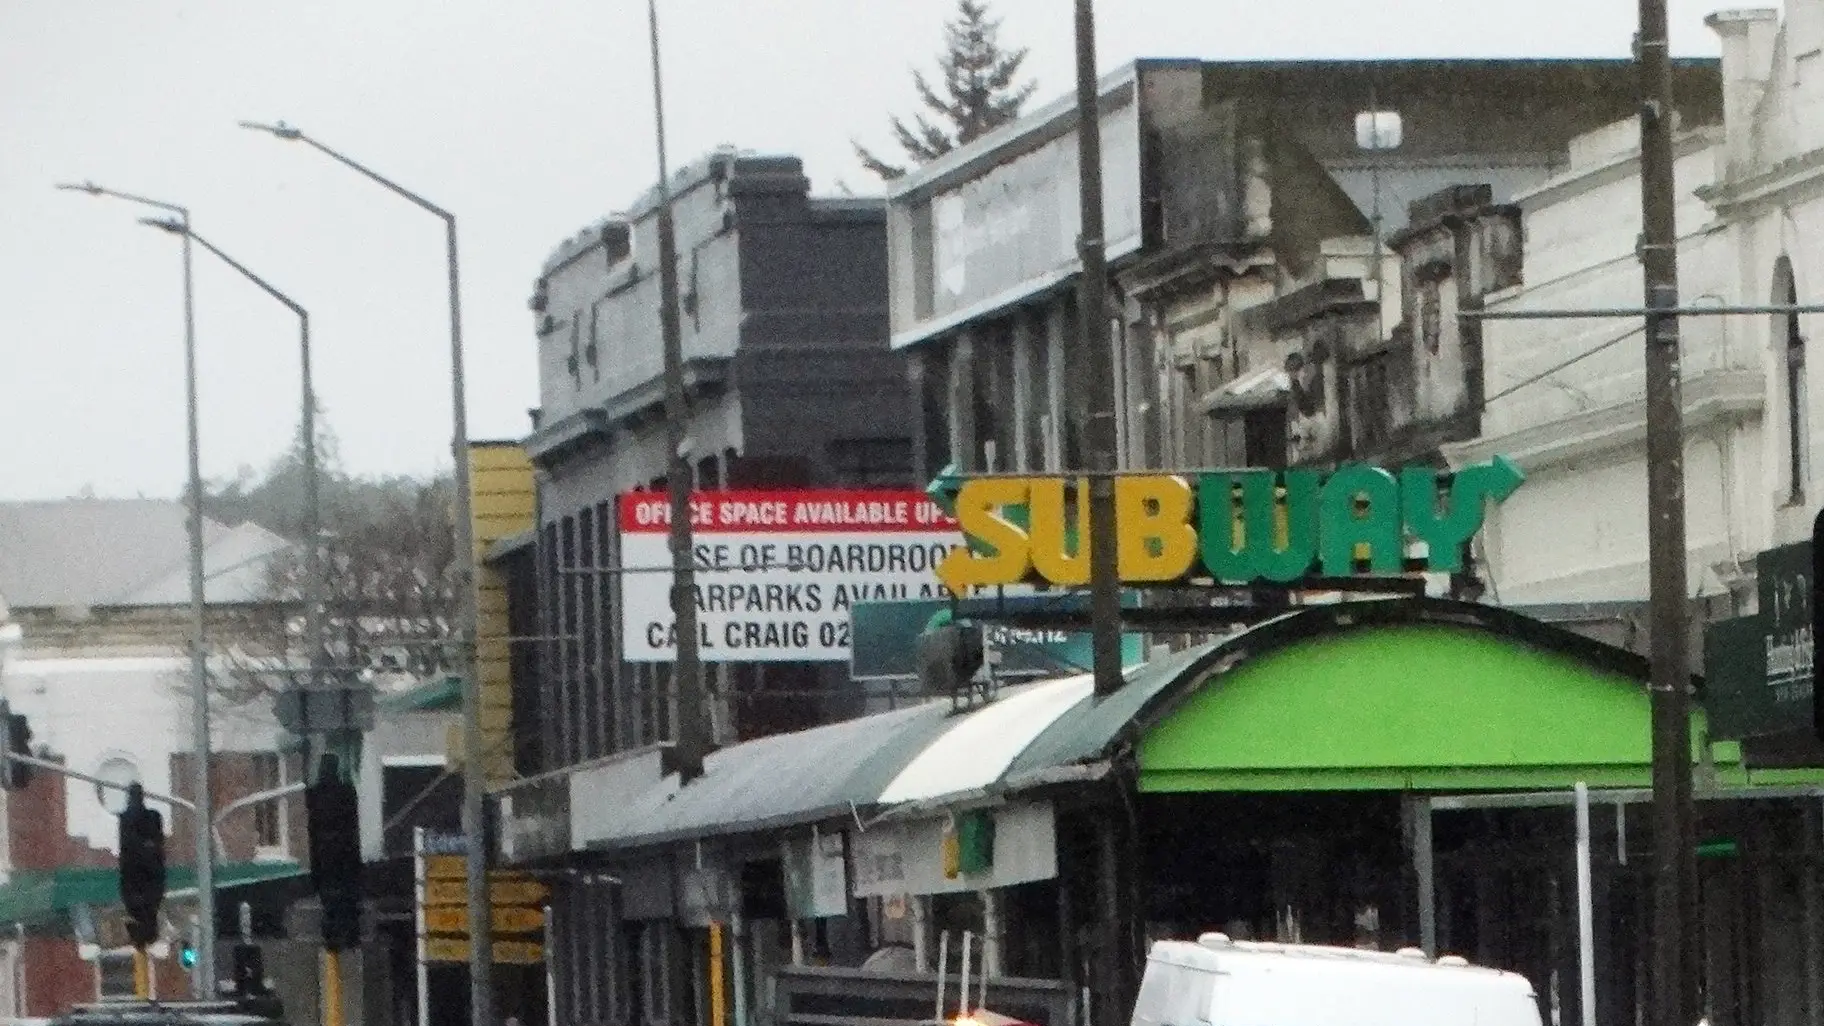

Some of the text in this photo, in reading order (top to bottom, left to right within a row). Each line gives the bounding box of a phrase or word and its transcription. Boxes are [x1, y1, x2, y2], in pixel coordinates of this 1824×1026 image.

[719, 501, 788, 525] SPACE
[794, 500, 908, 525] AVAILABLE
[935, 454, 1526, 597] SUBWAY
[740, 543, 777, 572] OF
[786, 541, 972, 574] BOARDROO
[724, 620, 809, 649] CRAIG
